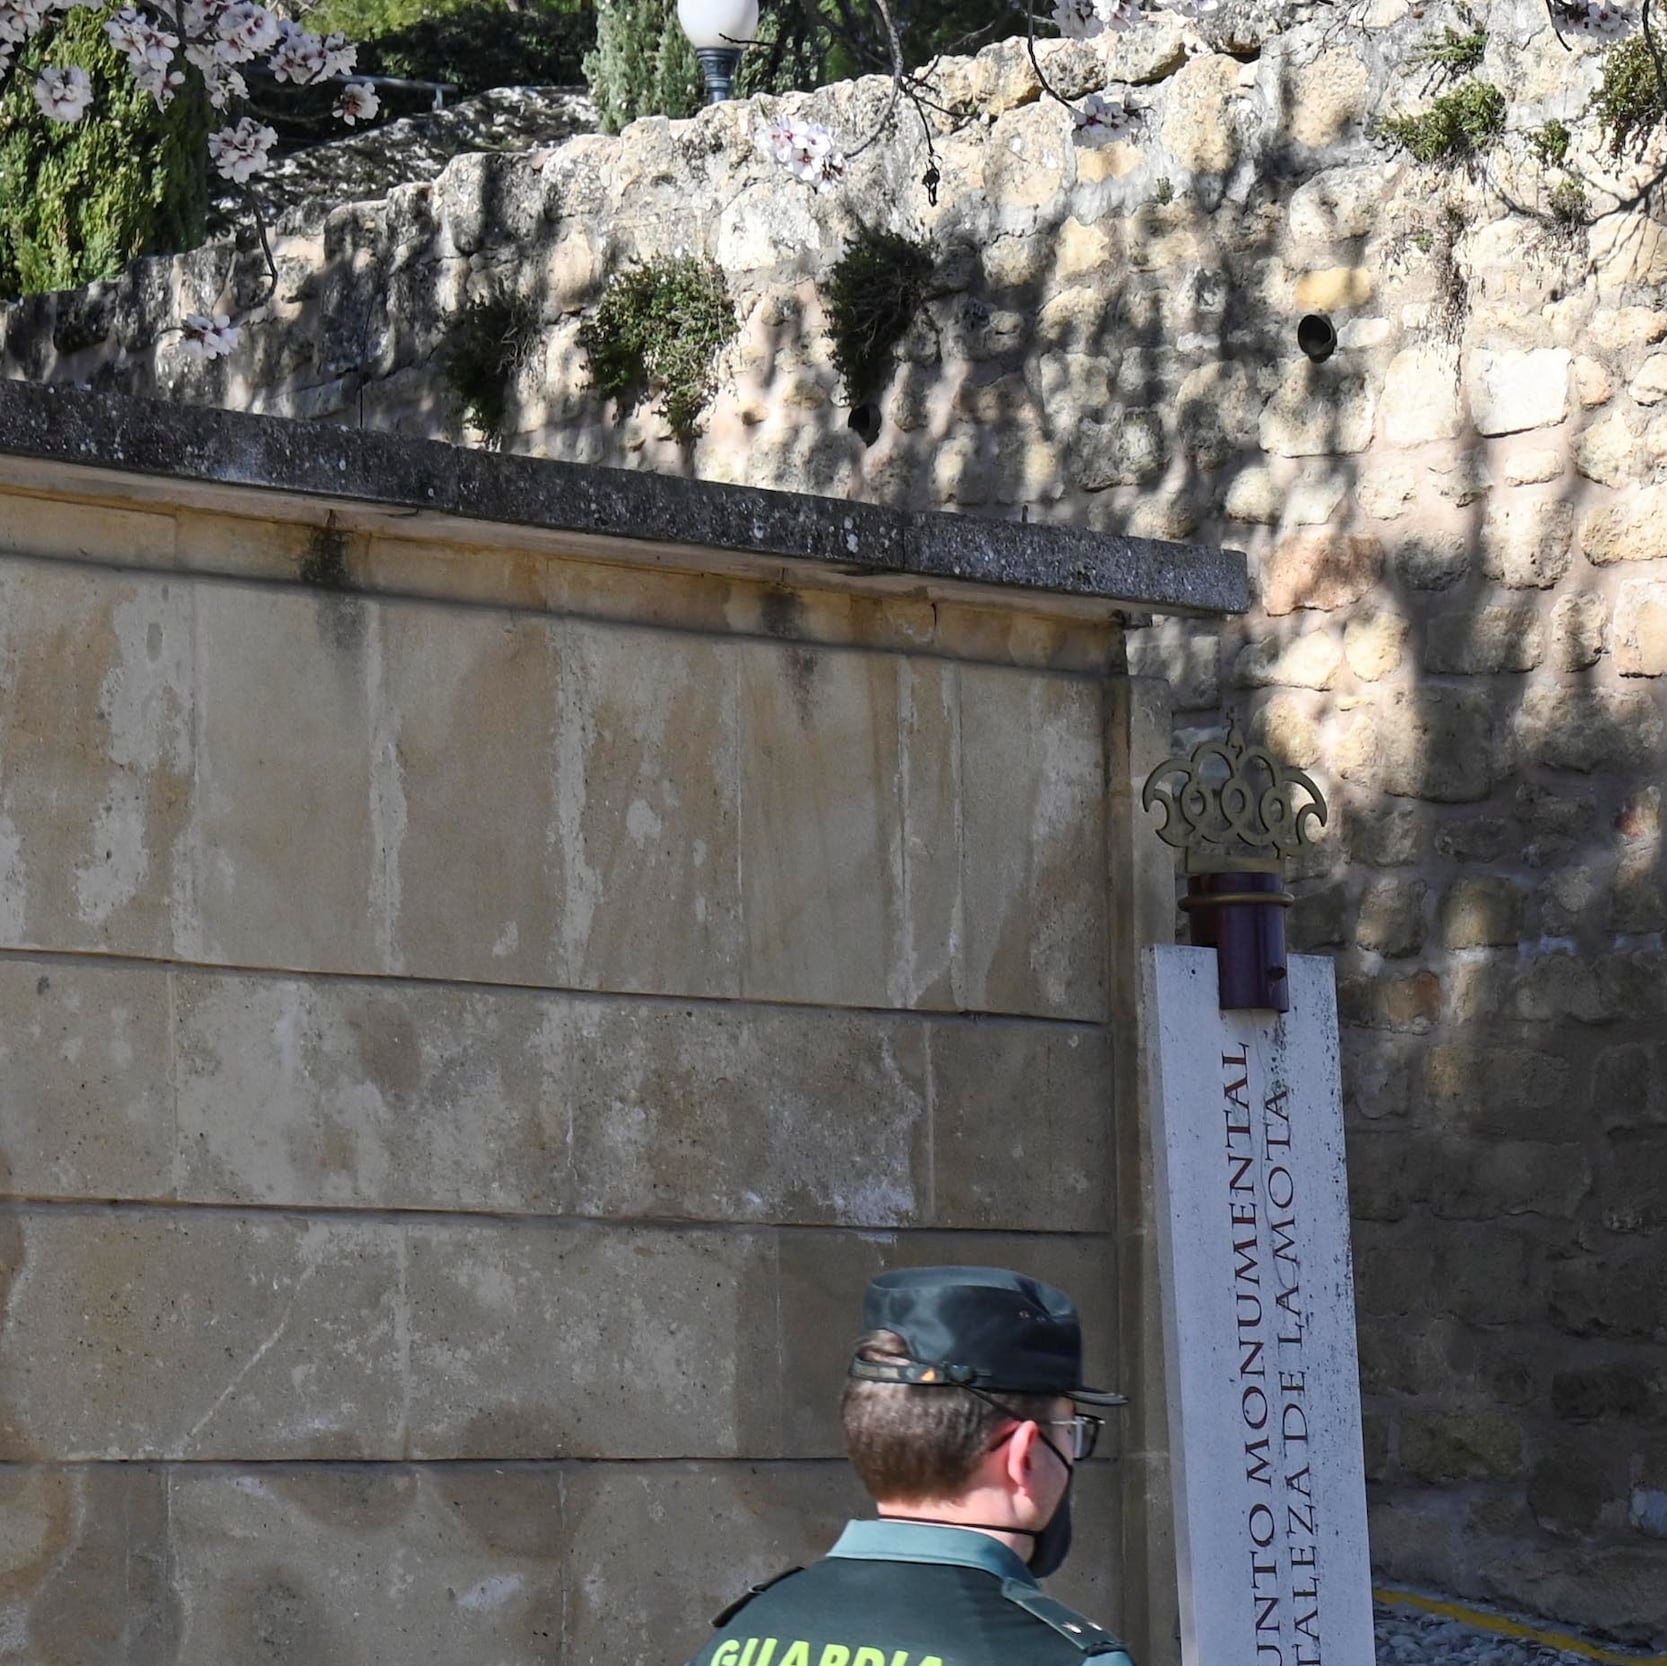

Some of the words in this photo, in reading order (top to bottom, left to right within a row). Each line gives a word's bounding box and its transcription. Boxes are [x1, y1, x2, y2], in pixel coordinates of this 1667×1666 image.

[1264, 1088, 1297, 1265] MOTA
[1221, 1041, 1272, 1487] MONUMENTAL
[1275, 1283, 1304, 1349] LA
[1280, 1370, 1310, 1445] DE
